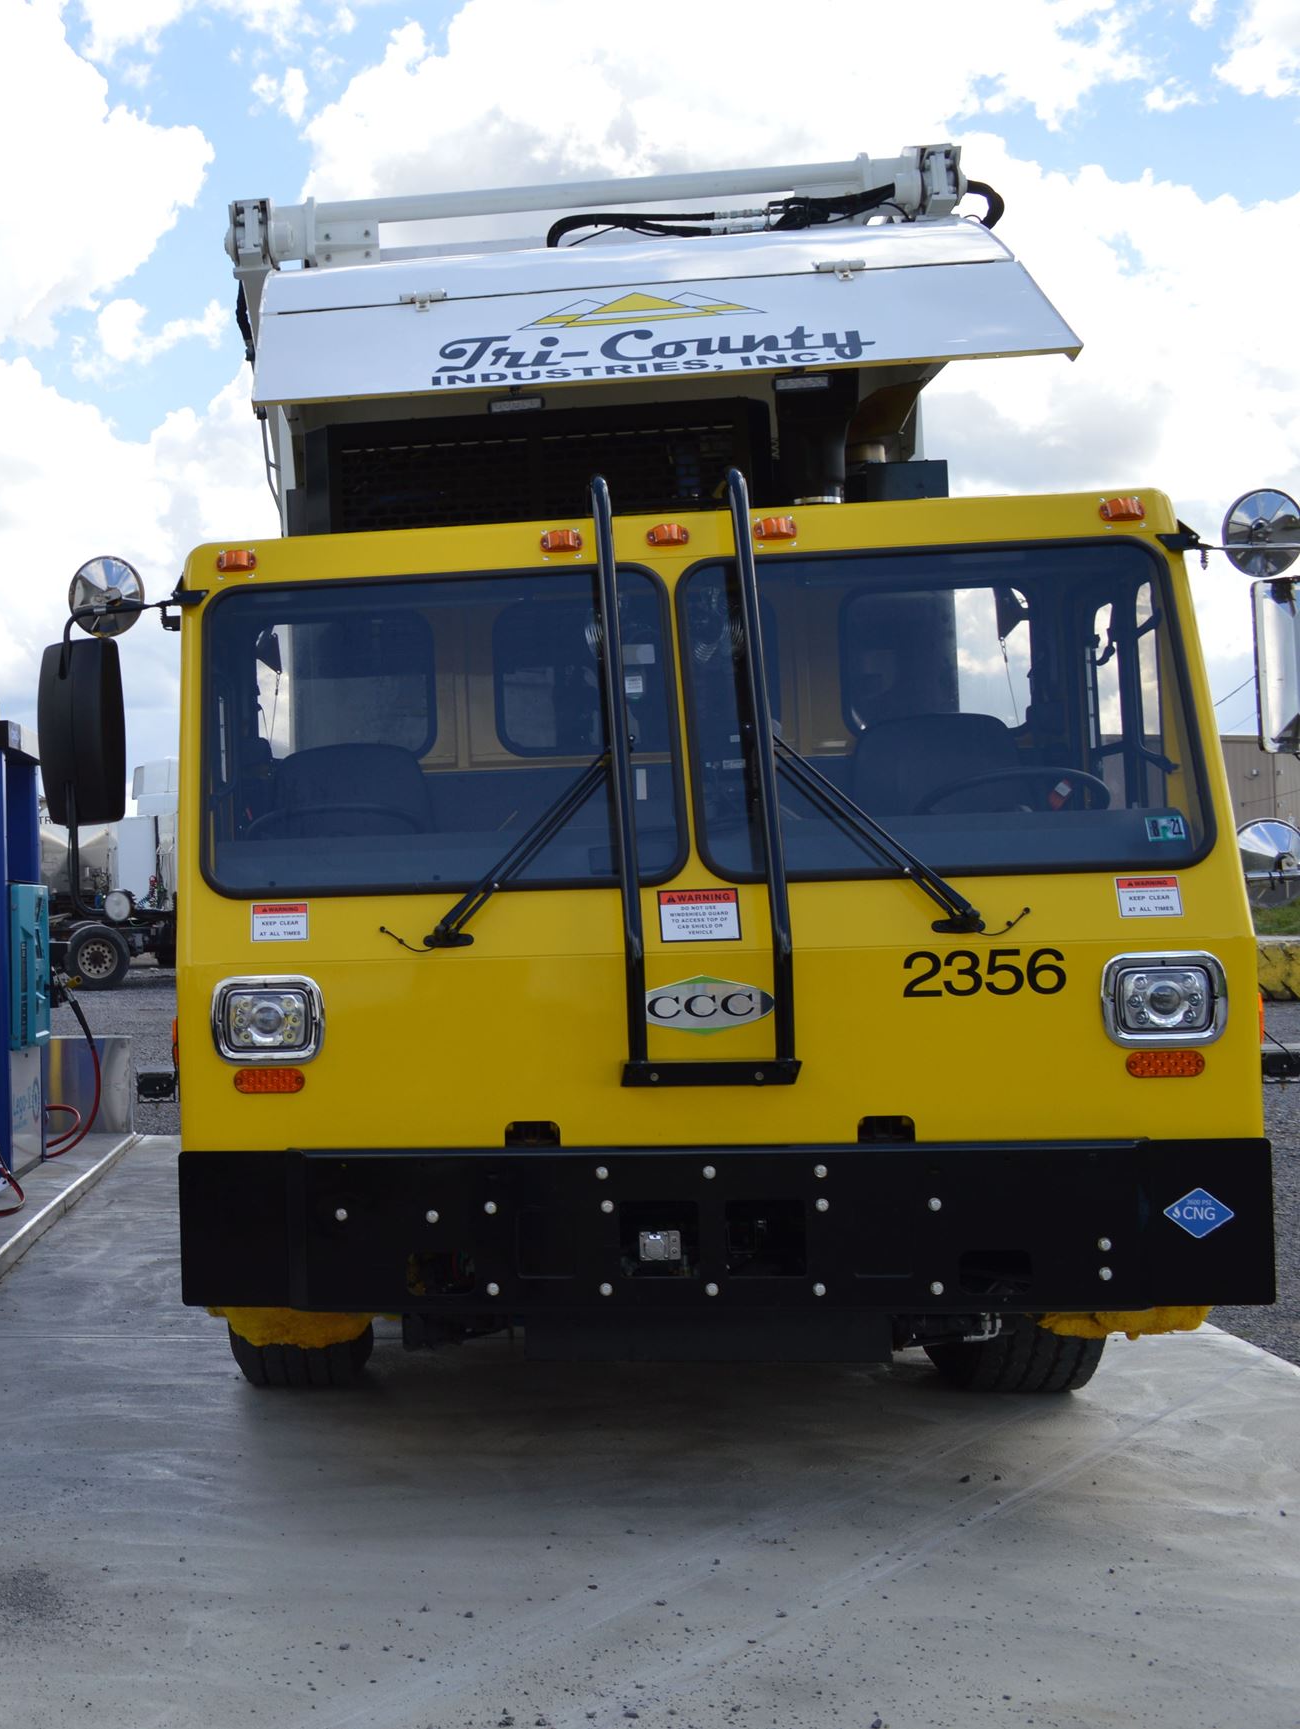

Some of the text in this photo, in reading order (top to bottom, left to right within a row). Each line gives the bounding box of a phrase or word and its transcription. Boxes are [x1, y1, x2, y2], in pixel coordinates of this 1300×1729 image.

[435, 325, 876, 372] Tri-County
[431, 350, 837, 386] INDUSTRIES, INC.
[677, 893, 731, 902] WARNING
[903, 948, 1067, 998] 2356
[647, 993, 755, 1019] CCC
[1182, 1206, 1216, 1220] CNG
